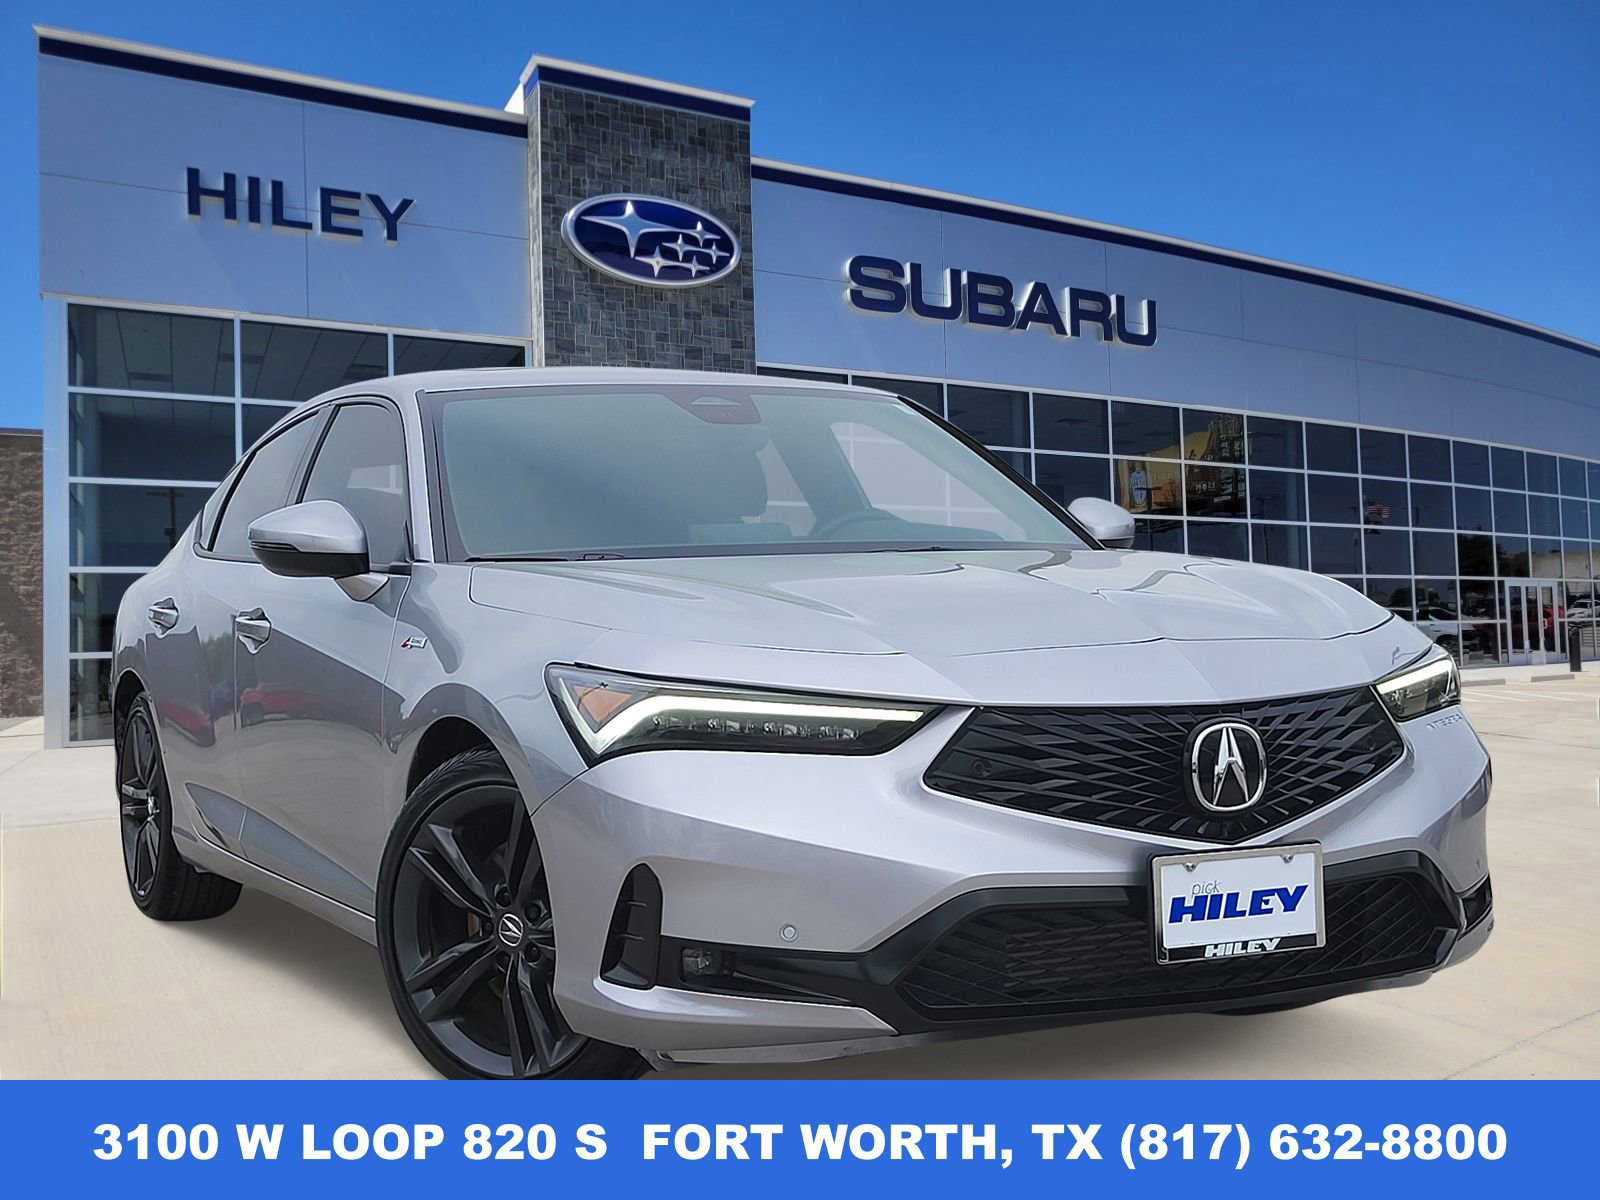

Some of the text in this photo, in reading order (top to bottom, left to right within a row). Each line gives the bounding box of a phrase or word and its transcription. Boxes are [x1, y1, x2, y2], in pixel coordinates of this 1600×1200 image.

[187, 167, 414, 242] HILEY
[847, 255, 1157, 346] SUBARU
[1169, 885, 1308, 924] HILEY
[1192, 880, 1221, 897] pick
[1204, 938, 1281, 958] HILEY
